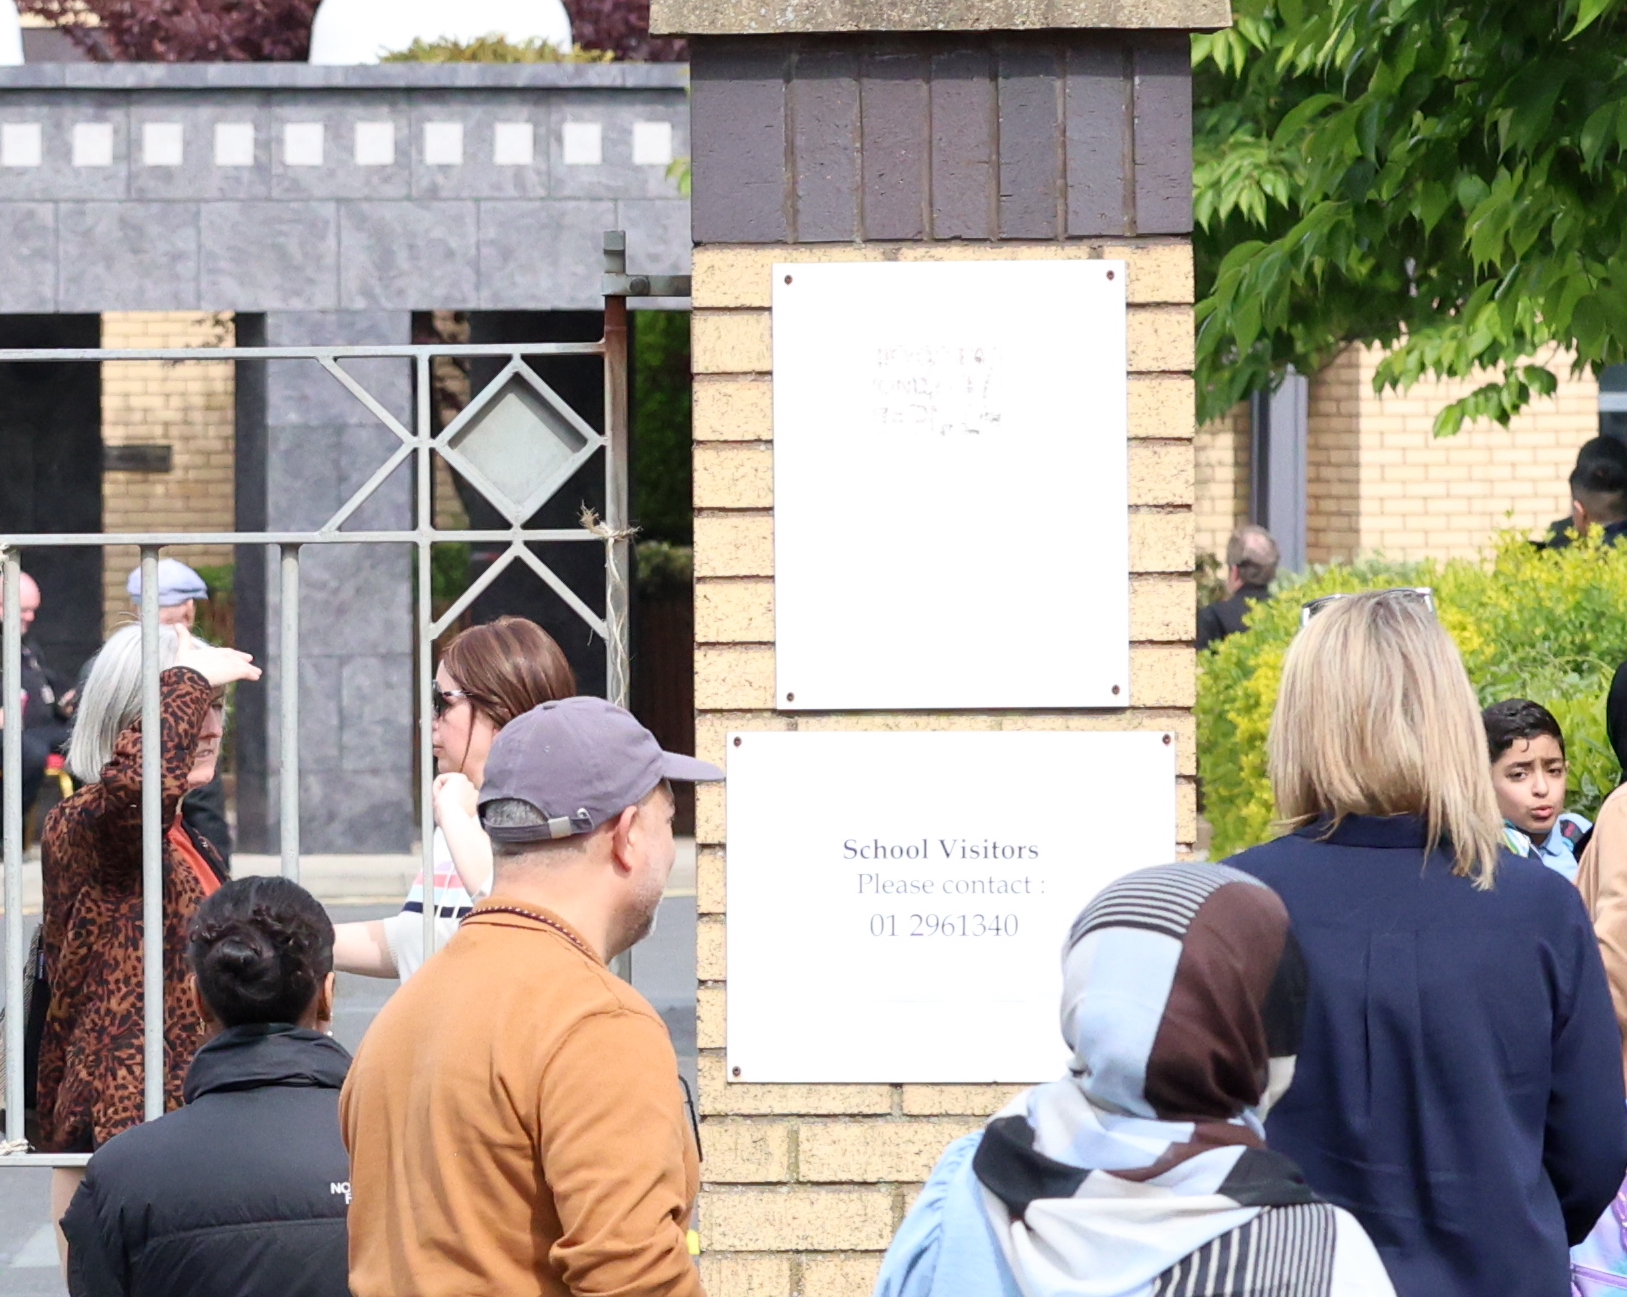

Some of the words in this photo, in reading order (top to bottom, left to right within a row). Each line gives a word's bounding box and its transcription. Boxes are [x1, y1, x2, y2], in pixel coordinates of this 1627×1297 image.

[842, 838, 930, 860] School
[937, 838, 1040, 860] Visitors
[857, 872, 935, 895] Please
[941, 875, 1032, 895] contact
[869, 913, 899, 937] 01
[909, 913, 1020, 937] 2961340
